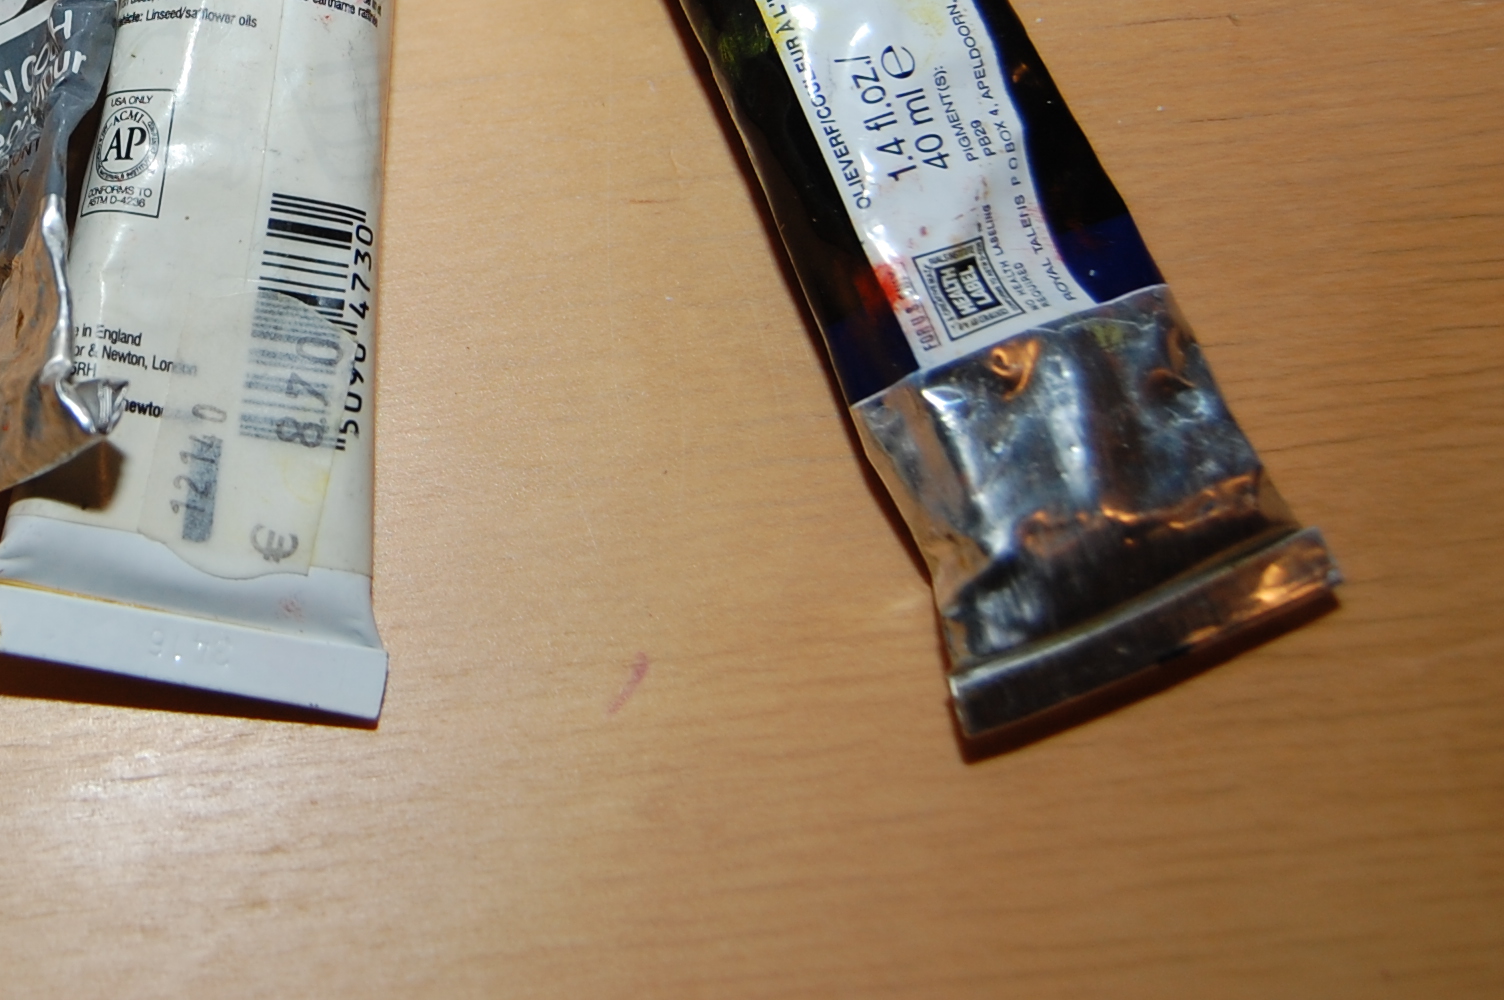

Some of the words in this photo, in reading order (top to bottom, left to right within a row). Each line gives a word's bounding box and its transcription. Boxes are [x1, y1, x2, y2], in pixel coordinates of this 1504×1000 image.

[238, 14, 258, 28] oils
[946, 0, 993, 100] APELDOORN,
[112, 109, 145, 127] ACMI
[128, 95, 154, 105] ONLY
[895, 88, 935, 131] ml
[933, 65, 979, 162] PIGMENT(S):
[101, 126, 147, 163] AP
[915, 132, 950, 170] 40
[970, 119, 997, 158] PB29
[994, 120, 1016, 151] BOX
[877, 136, 917, 183] 1.4
[88, 185, 135, 199] CONFORMS
[138, 187, 153, 198] TO
[982, 204, 1004, 257] LABELING
[349, 224, 374, 320] 4730
[939, 266, 978, 317] HEALTH
[958, 264, 994, 306] LABEL
[999, 260, 1027, 296] HEALTH
[1013, 261, 1051, 308] REQUIRED
[1041, 256, 1078, 302] ROYAL
[82, 323, 91, 337] in
[97, 325, 142, 347] England
[102, 345, 148, 370] Newton,
